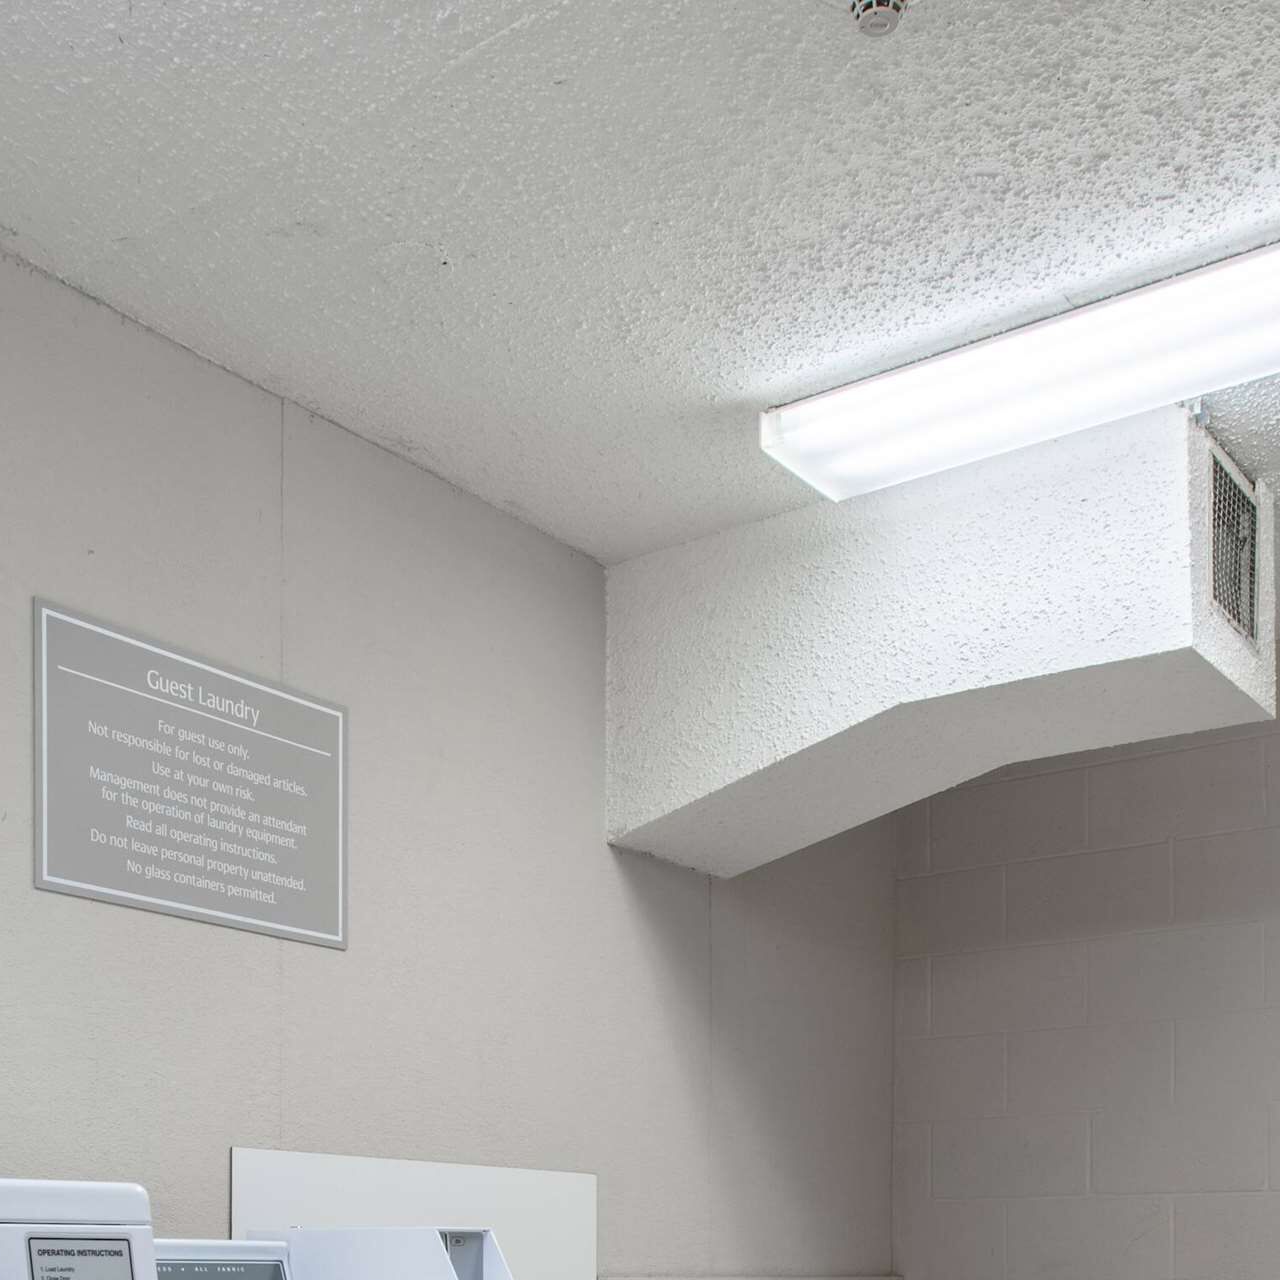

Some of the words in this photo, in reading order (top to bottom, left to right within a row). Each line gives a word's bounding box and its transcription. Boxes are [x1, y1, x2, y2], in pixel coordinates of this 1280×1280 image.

[146, 669, 195, 702] Guest
[199, 686, 260, 727] Laundry
[88, 720, 109, 738] Not
[111, 730, 172, 756] responsible
[175, 746, 190, 760] for
[192, 751, 211, 769] lost
[213, 761, 224, 771] or
[227, 762, 271, 786] damaged
[273, 777, 308, 797] articles.
[158, 720, 175, 736] For
[178, 728, 205, 746] guest
[208, 738, 225, 752] use
[227, 743, 250, 760] only.
[89, 765, 161, 797] Management
[163, 786, 189, 804] does
[190, 796, 208, 809] not
[210, 800, 247, 820] provide
[248, 811, 260, 823] an
[262, 815, 306, 836] attendant
[151, 761, 171, 778] Use
[174, 769, 184, 781] at
[186, 773, 210, 787] your
[212, 780, 233, 795] own
[235, 785, 255, 801] risk.
[102, 785, 118, 802] for
[121, 792, 138, 808] the
[141, 799, 191, 820] operation
[194, 812, 205, 824] of
[207, 813, 243, 837] laundry
[246, 827, 297, 849] equipment.
[126, 815, 152, 833] Read
[155, 824, 167, 837] all
[169, 829, 218, 851] operating
[220, 838, 278, 864] instructions.
[90, 828, 107, 844] Do
[109, 835, 128, 849] not
[131, 838, 158, 856] leave
[161, 848, 204, 866] personal
[207, 859, 248, 880] property
[251, 869, 306, 891] unattended.
[127, 859, 142, 874] No
[145, 864, 171, 881] glass
[173, 872, 225, 893] containers
[227, 885, 277, 904] permitted.
[37, 1248, 75, 1257] OPERATING
[76, 1249, 123, 1257] INSTRUCTIONS
